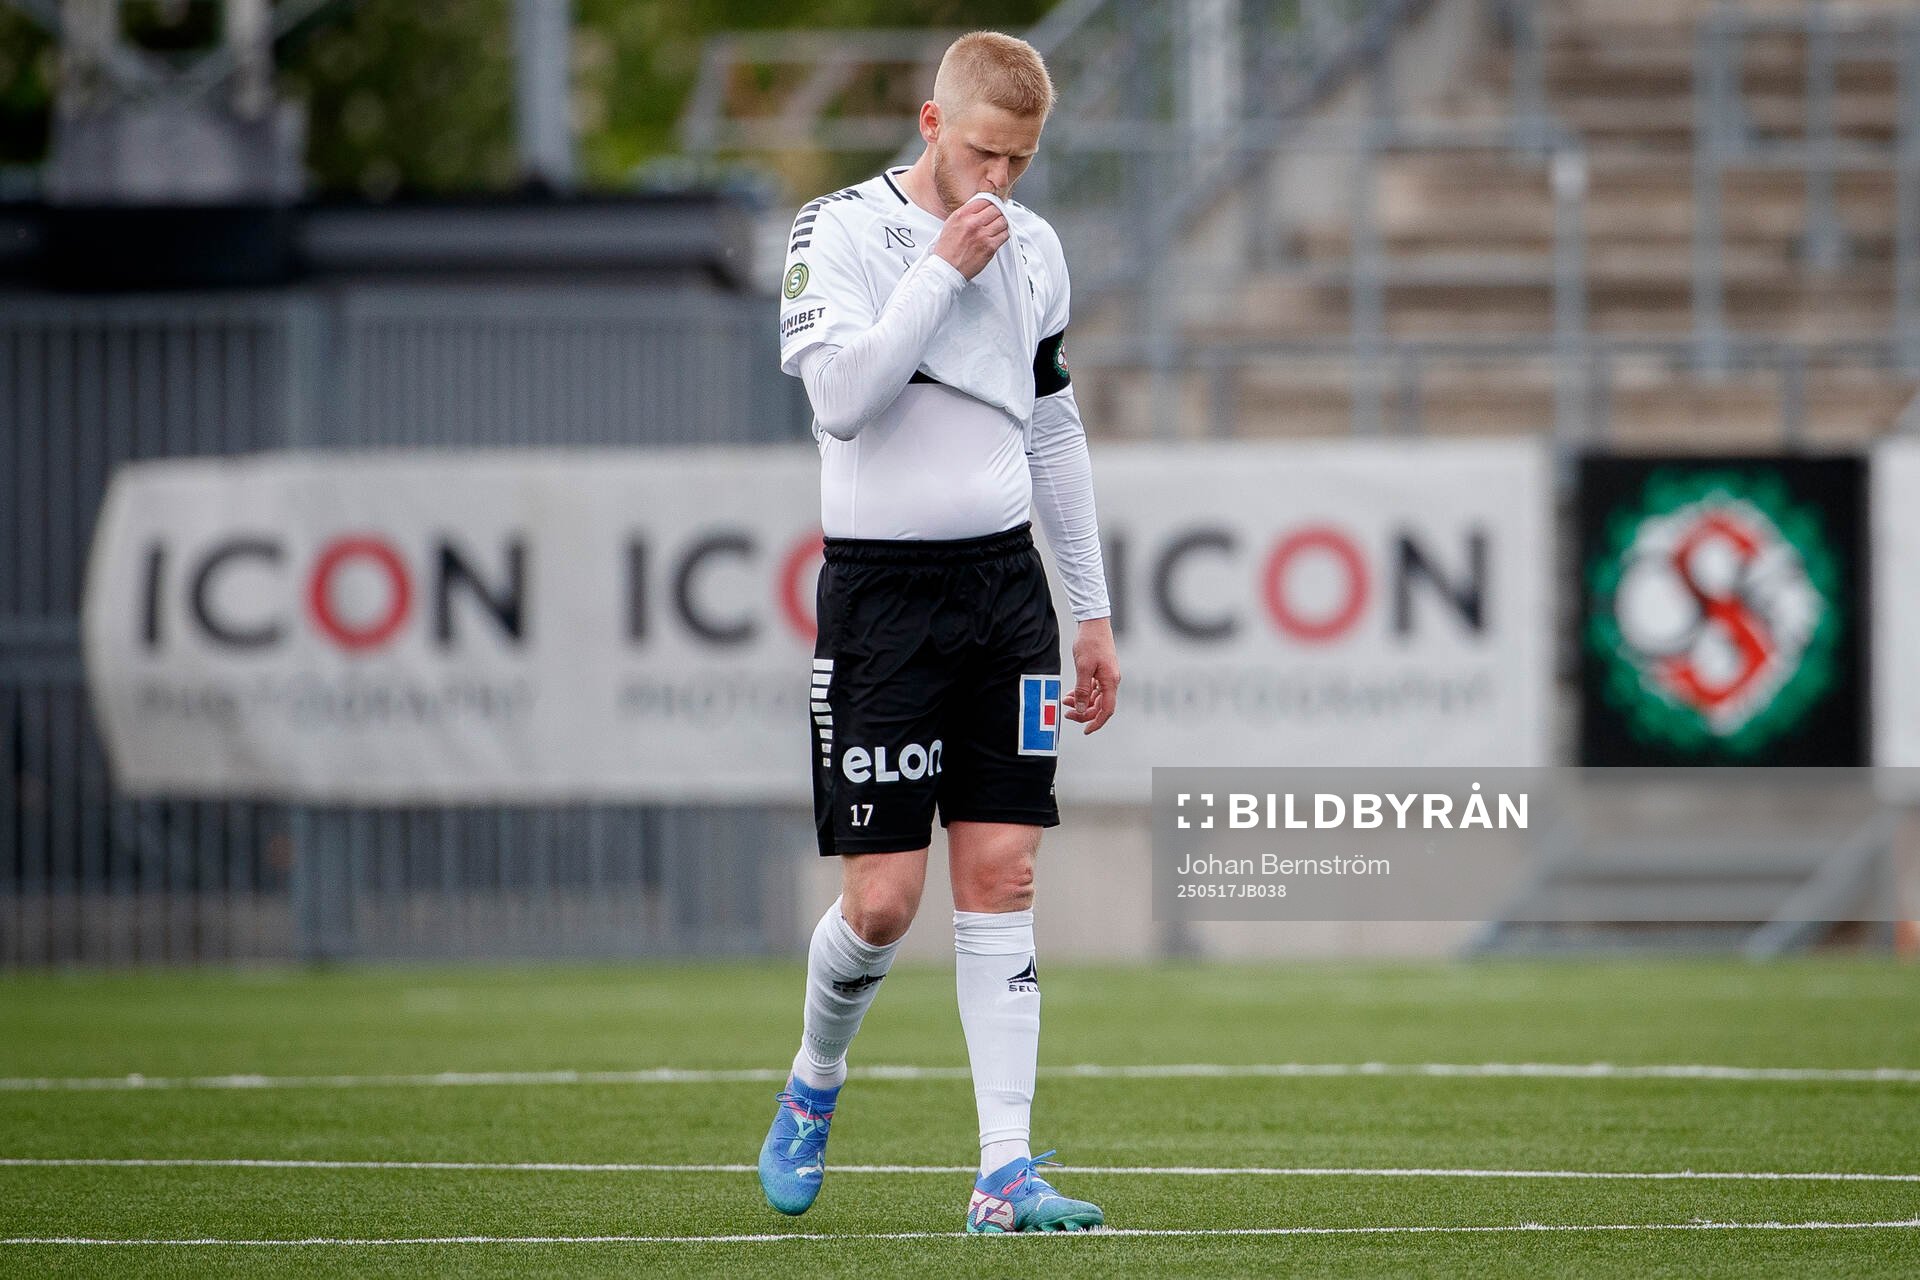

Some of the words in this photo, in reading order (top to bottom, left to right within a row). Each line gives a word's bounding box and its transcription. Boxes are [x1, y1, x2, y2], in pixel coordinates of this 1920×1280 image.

[781, 307, 826, 334] UNIBET
[138, 535, 530, 653] ICON
[1106, 524, 1492, 645] ICON
[850, 804, 874, 827] 17
